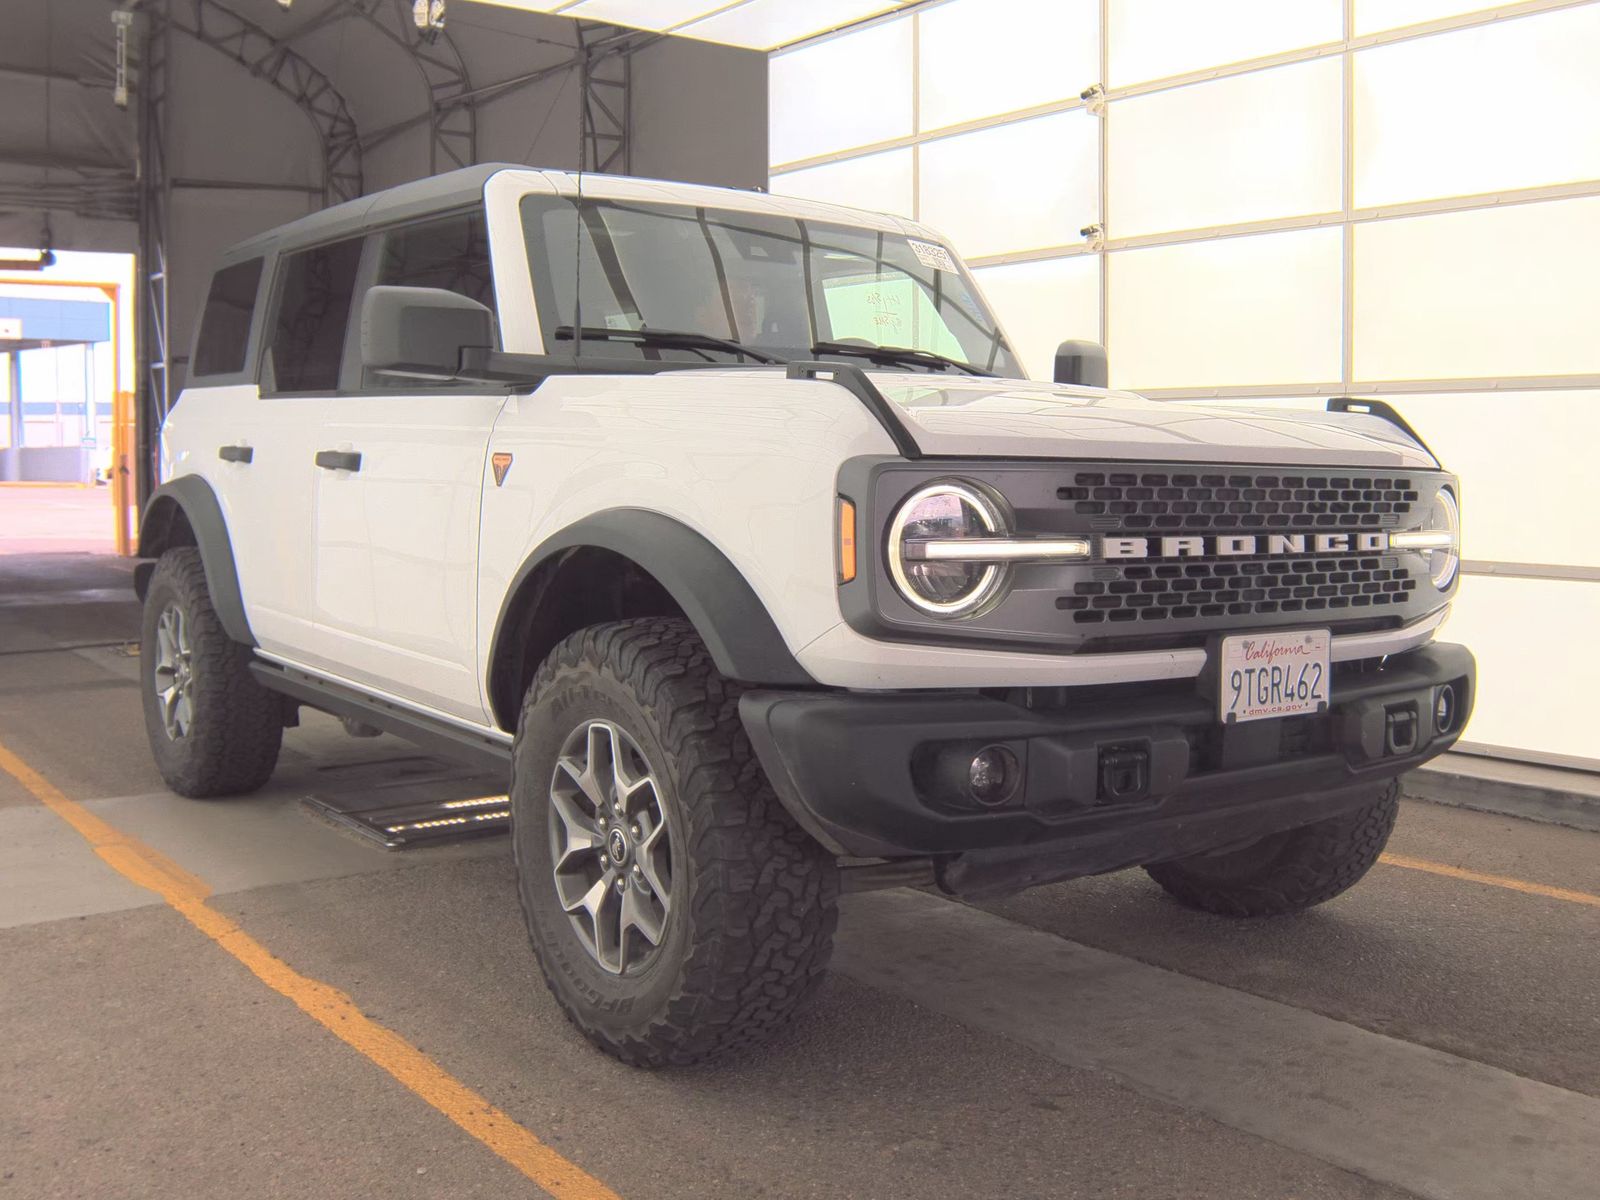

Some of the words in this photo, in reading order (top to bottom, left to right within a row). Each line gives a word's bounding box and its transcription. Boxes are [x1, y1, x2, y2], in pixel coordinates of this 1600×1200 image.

[1102, 532, 1389, 559] BRONCO
[1245, 640, 1311, 664] California
[1231, 662, 1322, 710] 9TGR462
[1248, 703, 1303, 716] dmv.ca.gov
